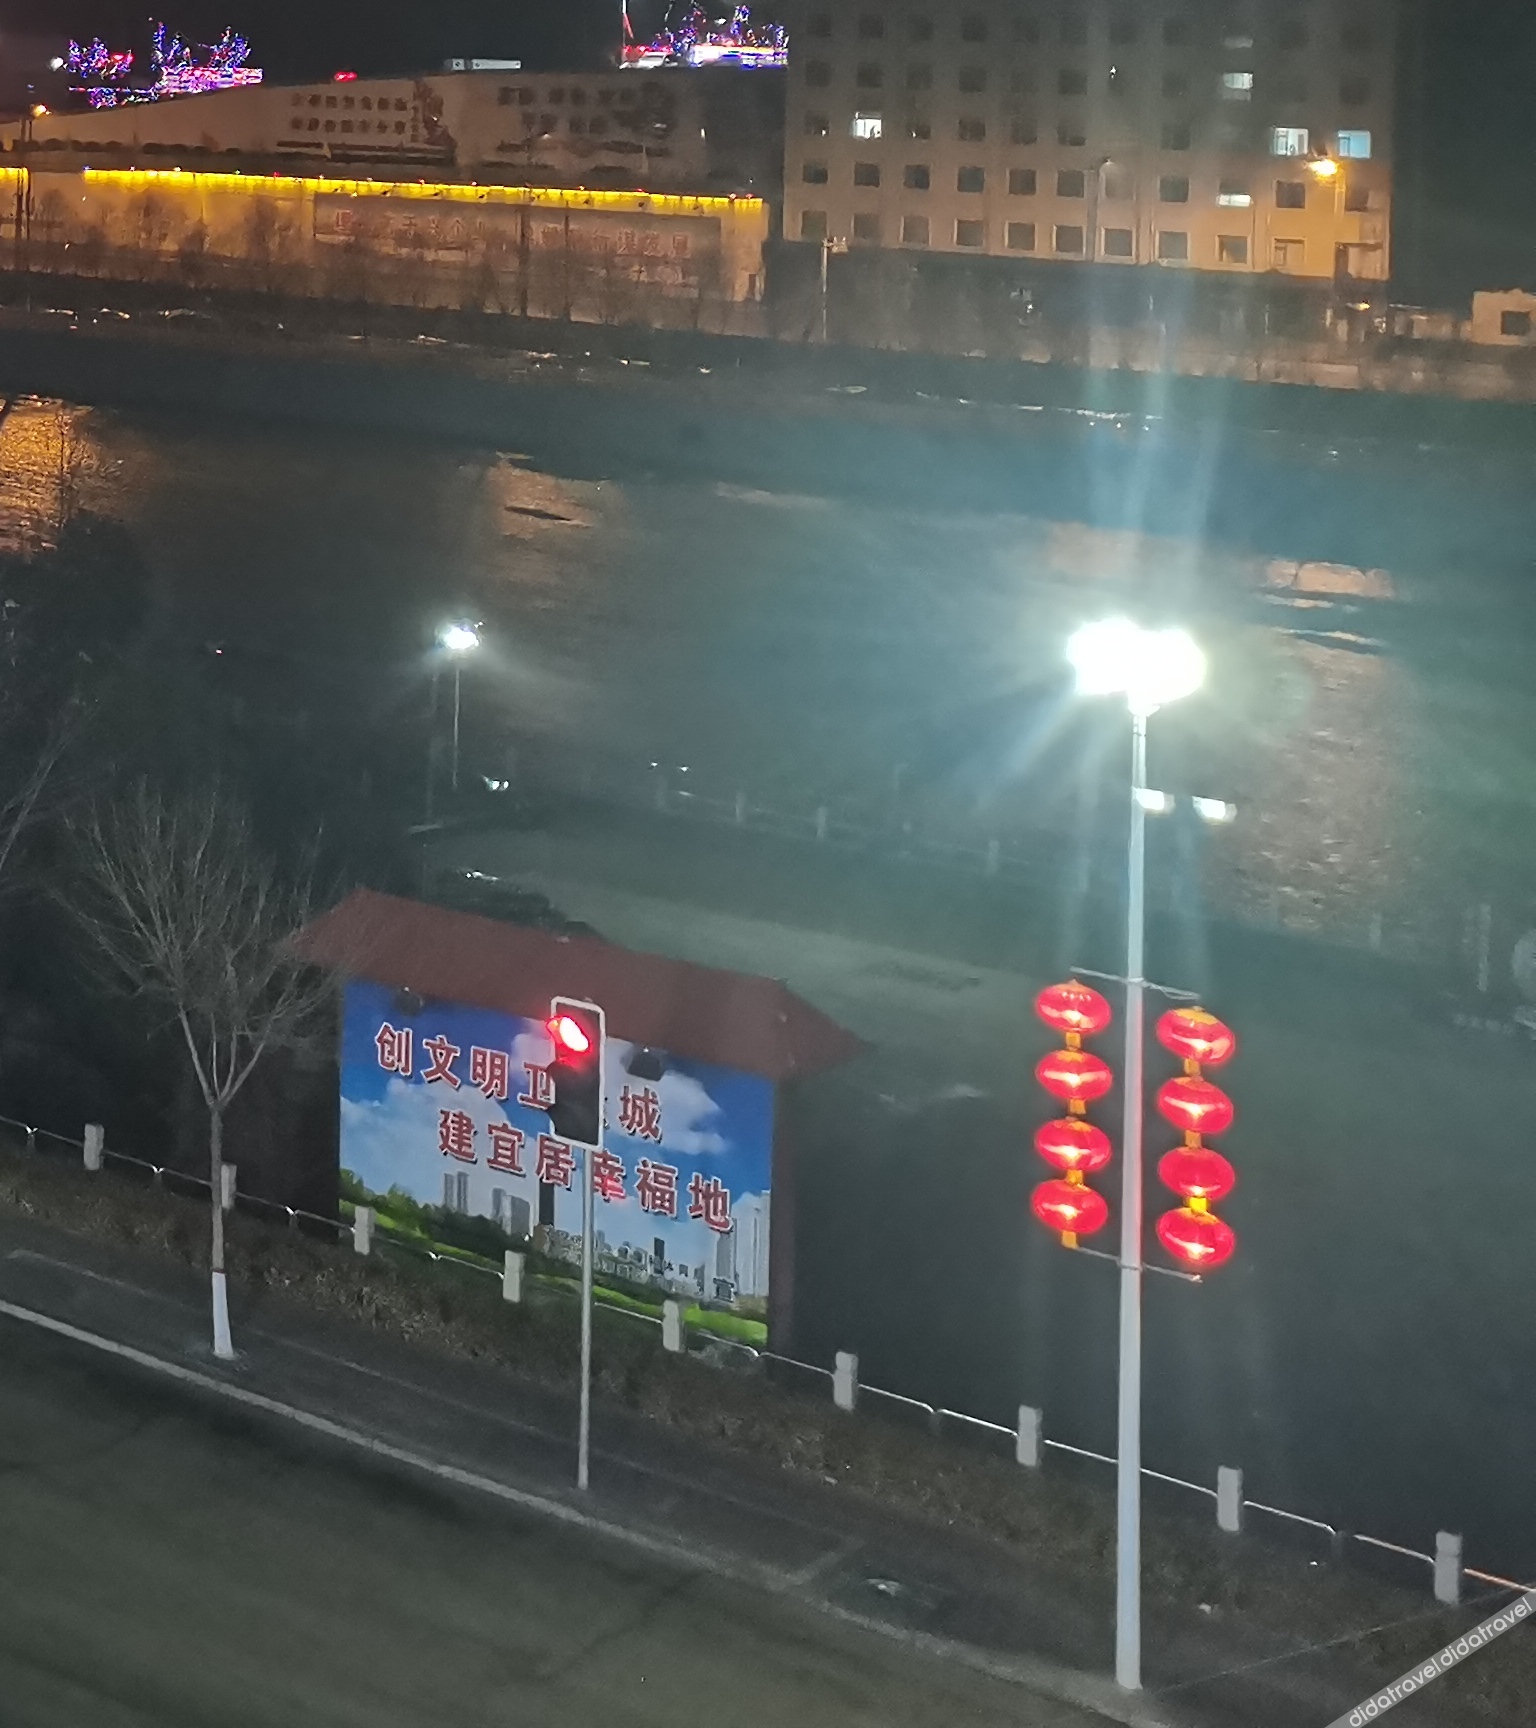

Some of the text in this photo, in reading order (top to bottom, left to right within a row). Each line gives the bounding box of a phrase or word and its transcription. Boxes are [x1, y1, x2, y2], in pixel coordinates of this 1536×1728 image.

[375, 1022, 662, 1141] 创文明卫城
[437, 1107, 734, 1232] 建宜居幸福地
